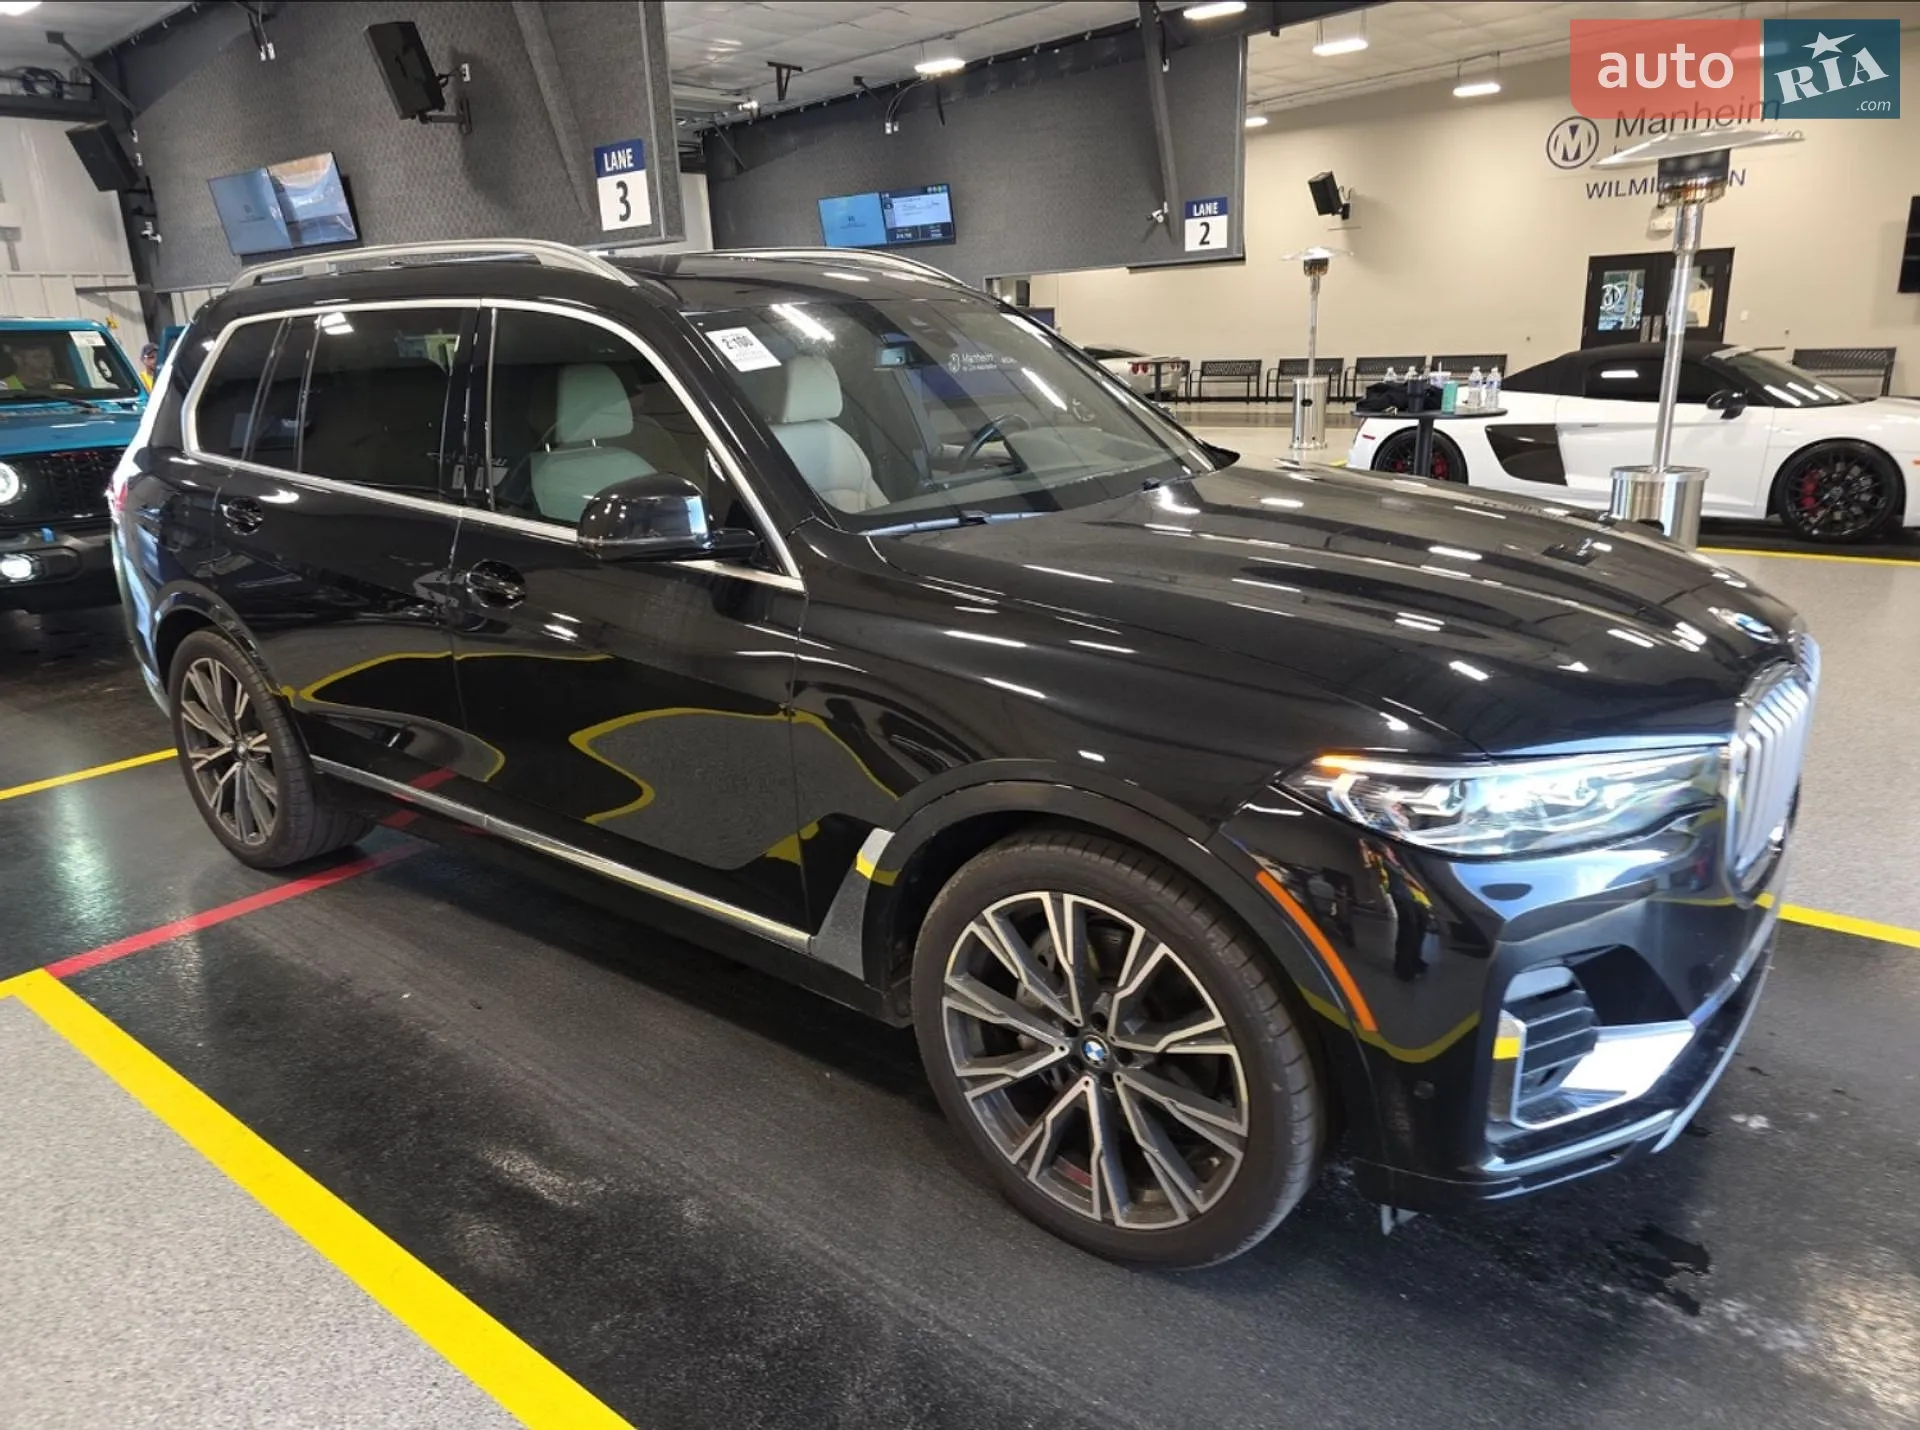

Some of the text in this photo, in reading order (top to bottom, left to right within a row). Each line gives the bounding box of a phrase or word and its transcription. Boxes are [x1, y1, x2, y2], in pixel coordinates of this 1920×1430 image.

[1615, 96, 1781, 138] Manheim
[603, 147, 635, 172] LANE
[1585, 168, 1747, 199] WILMIN
[616, 180, 632, 222] 3
[1193, 201, 1219, 217] LANE
[1199, 221, 1210, 246] 2
